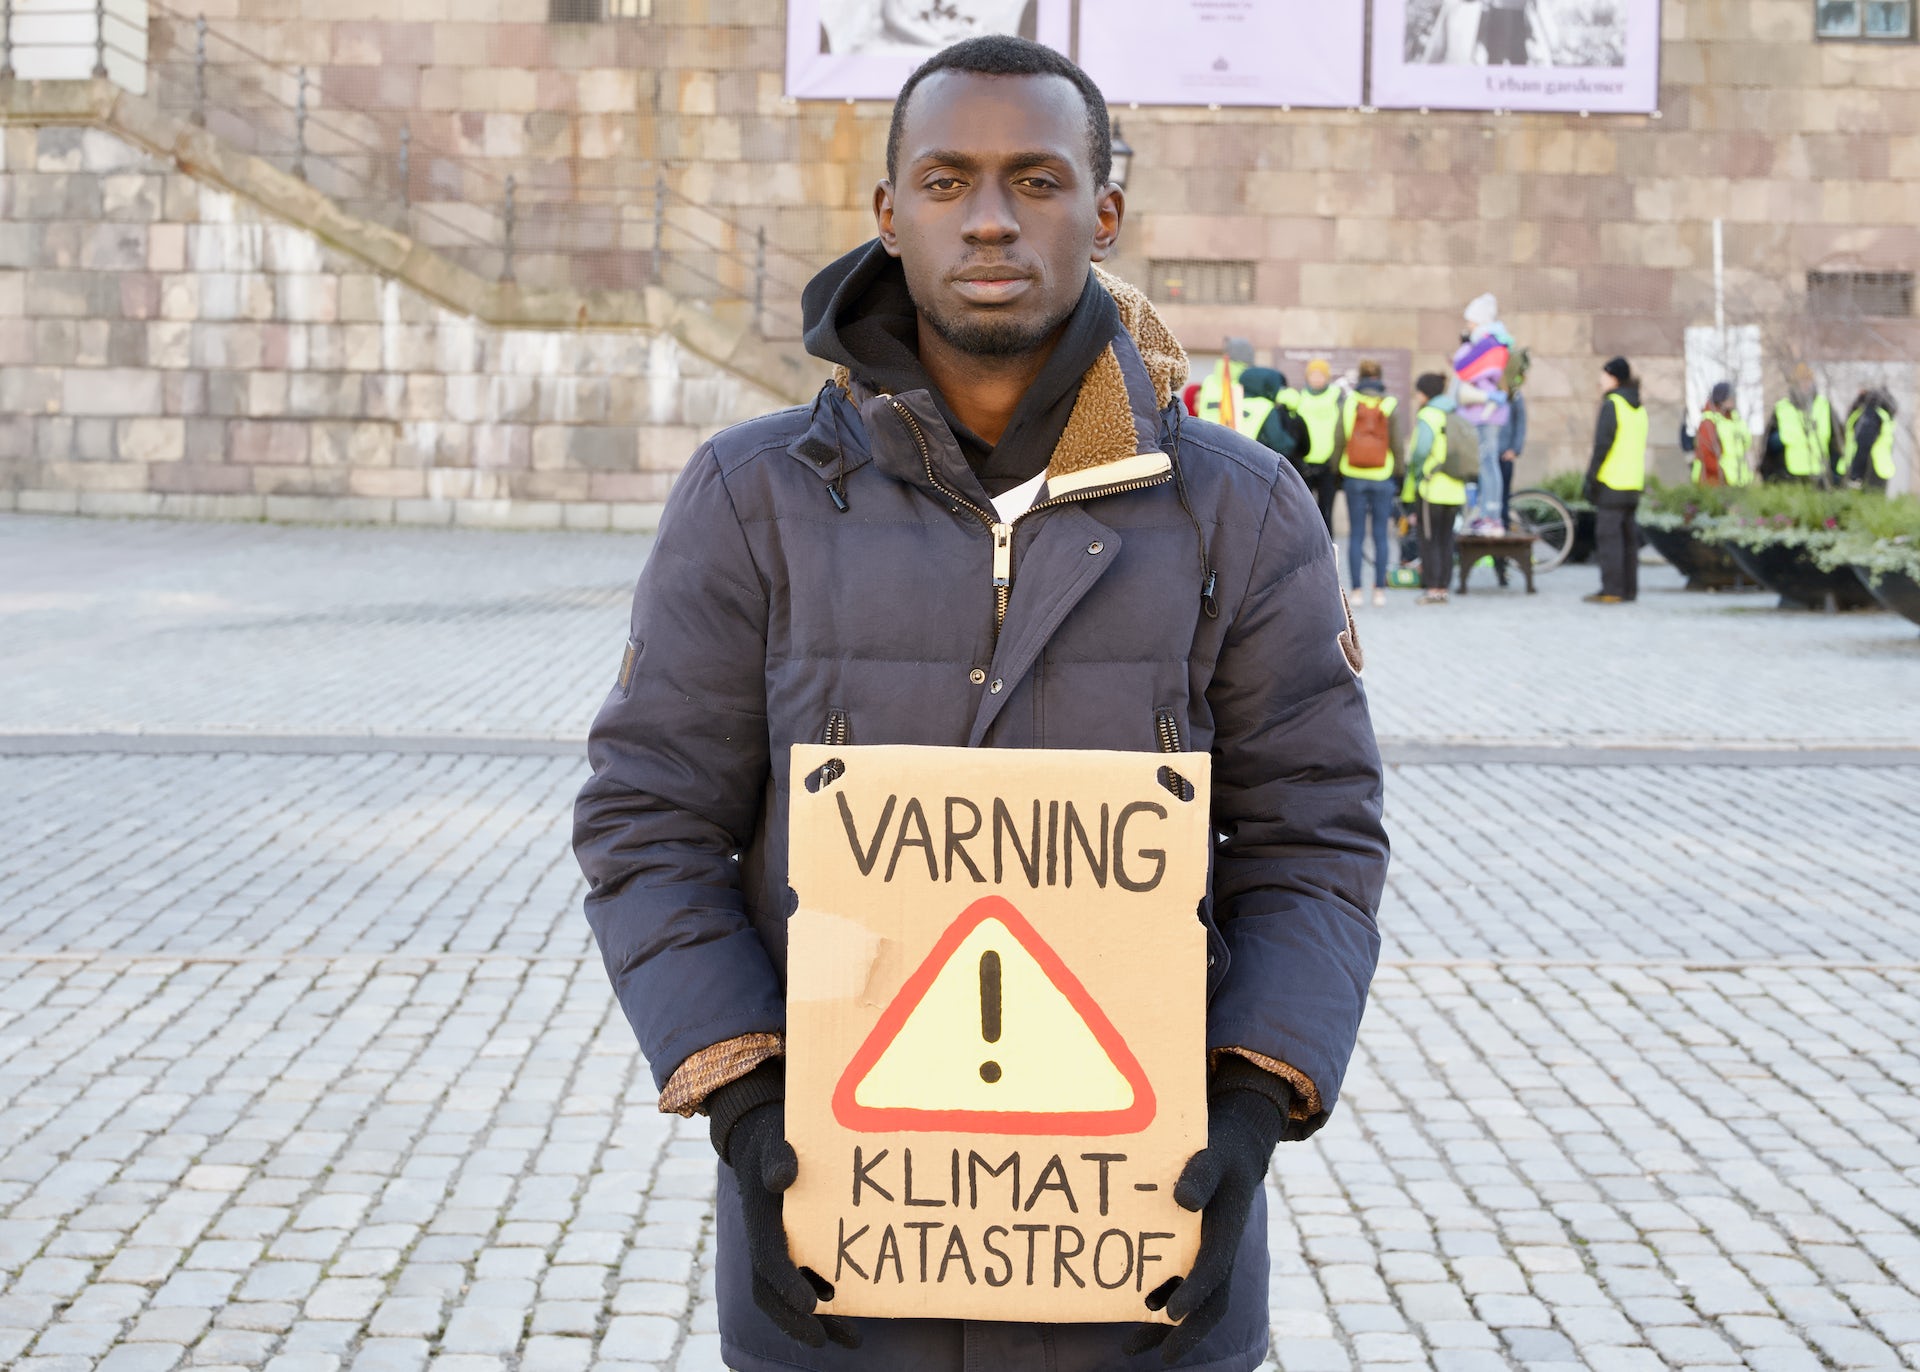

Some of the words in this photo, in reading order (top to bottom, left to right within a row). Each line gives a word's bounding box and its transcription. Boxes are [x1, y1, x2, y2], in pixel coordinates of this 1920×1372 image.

[1485, 76, 1542, 92] Urban
[1543, 76, 1625, 96] gardener
[835, 790, 1168, 893] VARNING
[852, 1145, 1159, 1216] KLIMAT-
[835, 1217, 1176, 1293] KATASTROF
